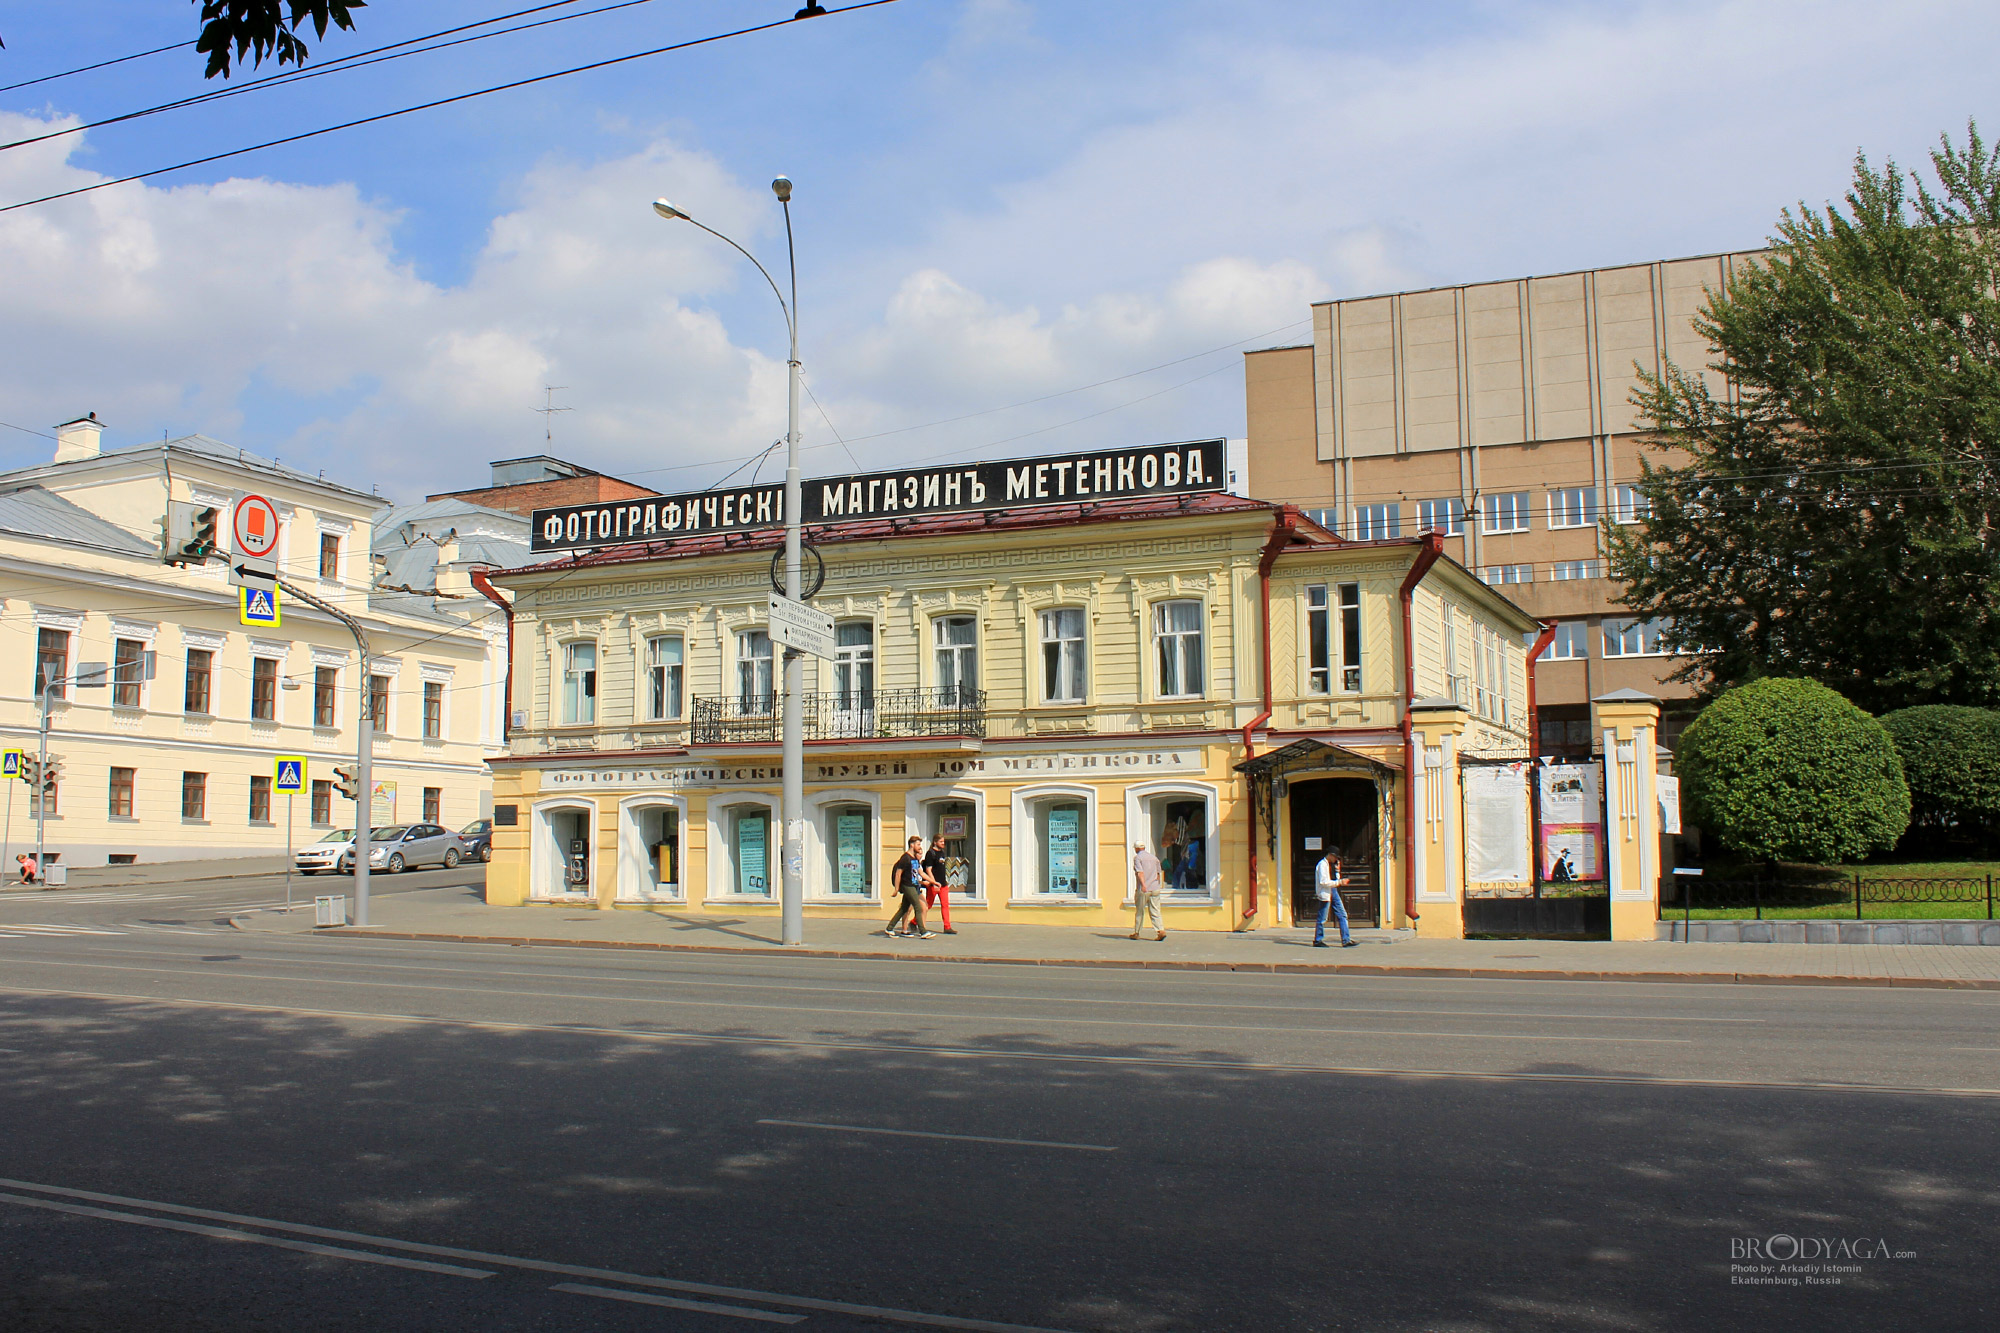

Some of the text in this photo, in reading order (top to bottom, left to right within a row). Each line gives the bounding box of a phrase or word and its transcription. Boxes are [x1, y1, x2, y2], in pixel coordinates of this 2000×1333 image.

[544, 449, 1213, 544] ФОТОГРАФИЧЕСКІ МАГАЗИНЪ МЕТЕНКОВА.
[789, 603, 824, 621] ПЕРВОМАЙСКАЯ
[788, 612, 826, 632] PERVOMAYSKAYA
[791, 627, 822, 643] ФИЛАРМОНИЯ
[791, 637, 823, 653] PHILHARMONIC
[553, 753, 1182, 784] ФОТОГРАФИЧЕСКИ МУЗЕЙ ДОМ МЕТЕНКОВА
